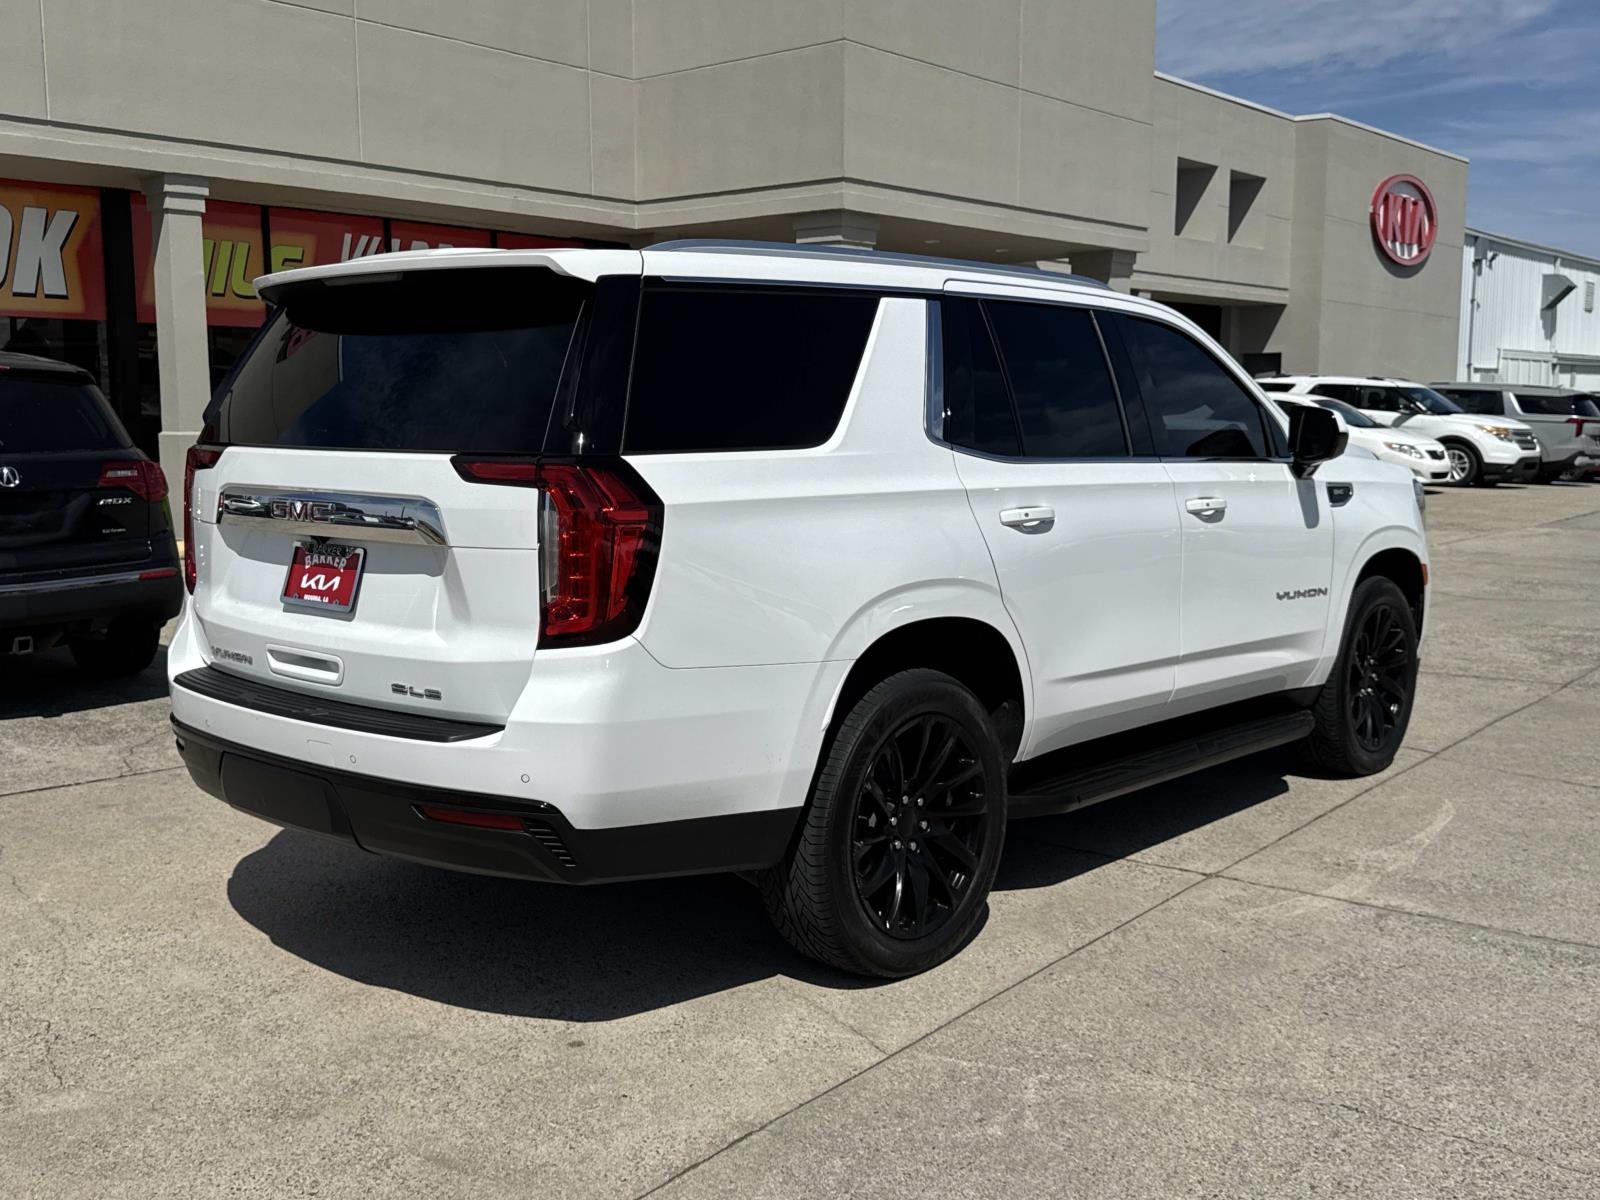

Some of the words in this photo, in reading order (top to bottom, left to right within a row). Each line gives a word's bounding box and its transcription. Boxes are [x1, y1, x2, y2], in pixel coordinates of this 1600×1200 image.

[1380, 191, 1431, 252] KIA
[271, 500, 336, 524] GMC
[300, 573, 341, 592] KIA
[1276, 587, 1328, 601] YUKON
